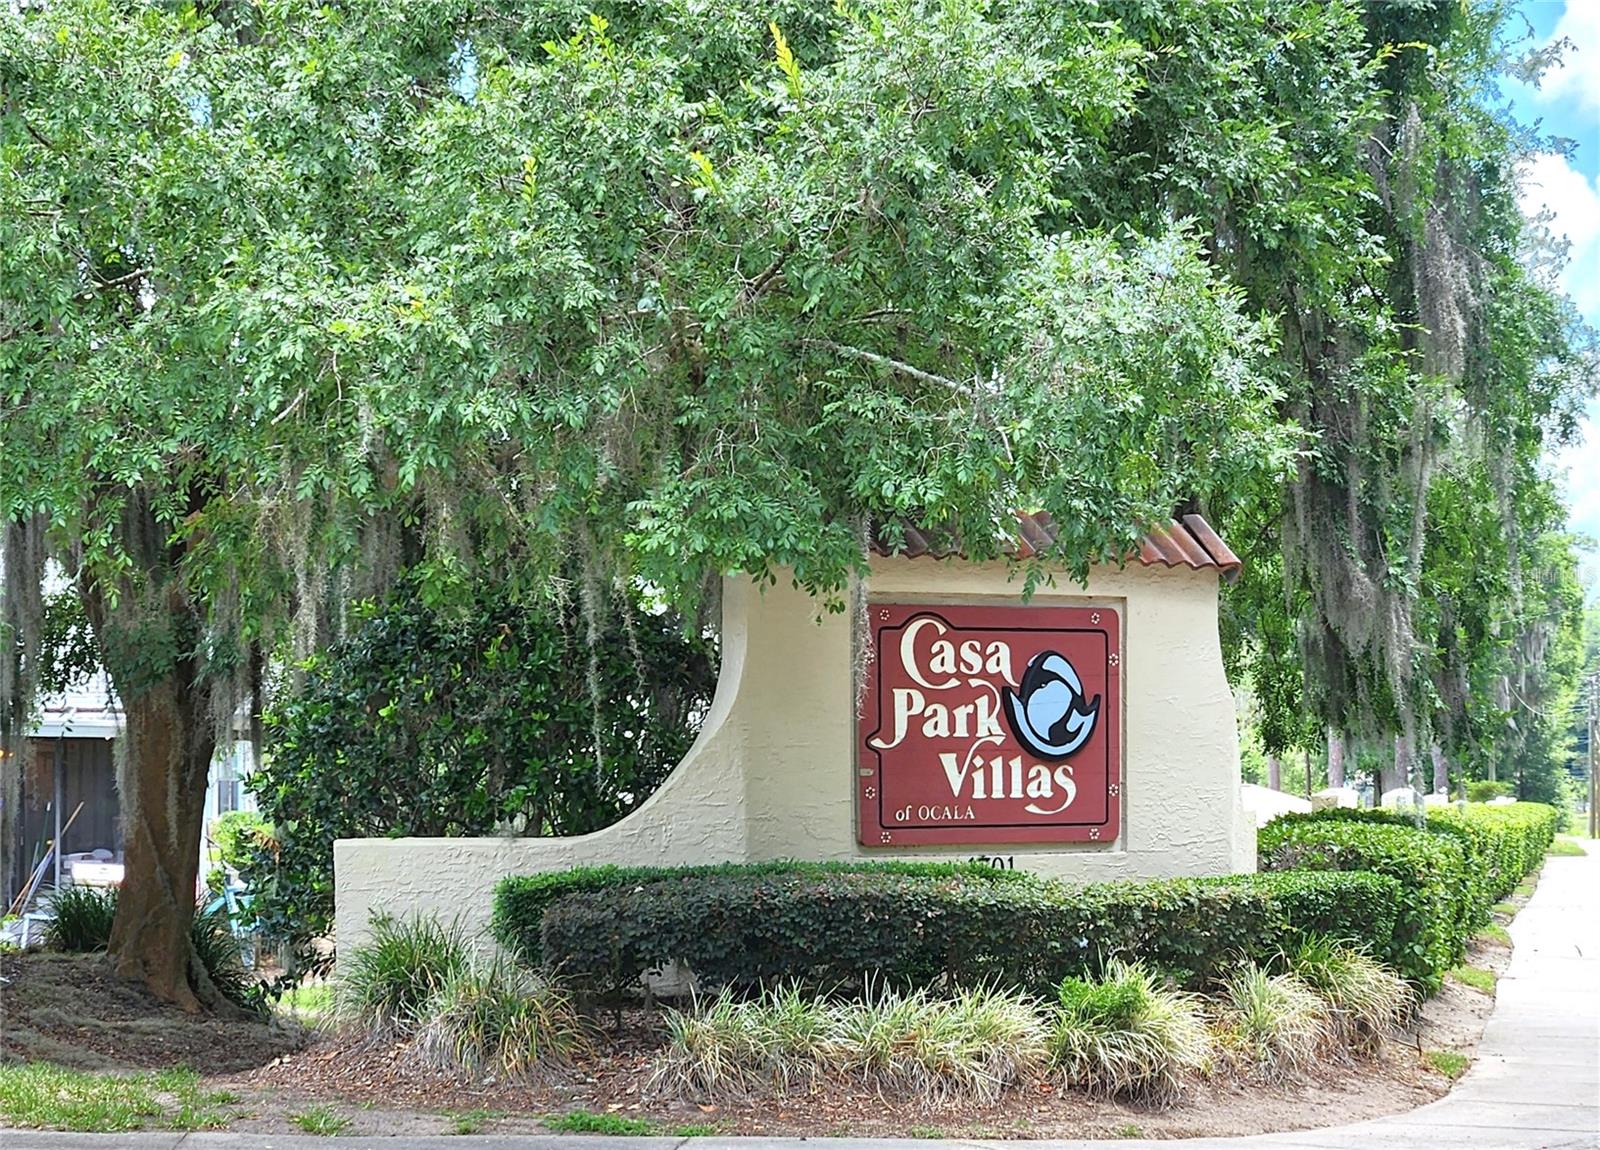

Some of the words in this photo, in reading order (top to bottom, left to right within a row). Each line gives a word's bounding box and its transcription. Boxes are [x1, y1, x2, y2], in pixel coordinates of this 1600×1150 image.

[900, 618, 1020, 689] Casa
[870, 678, 1006, 749] Park
[939, 735, 1077, 815] Villas
[895, 805, 912, 821] of
[918, 805, 975, 820] OCALA
